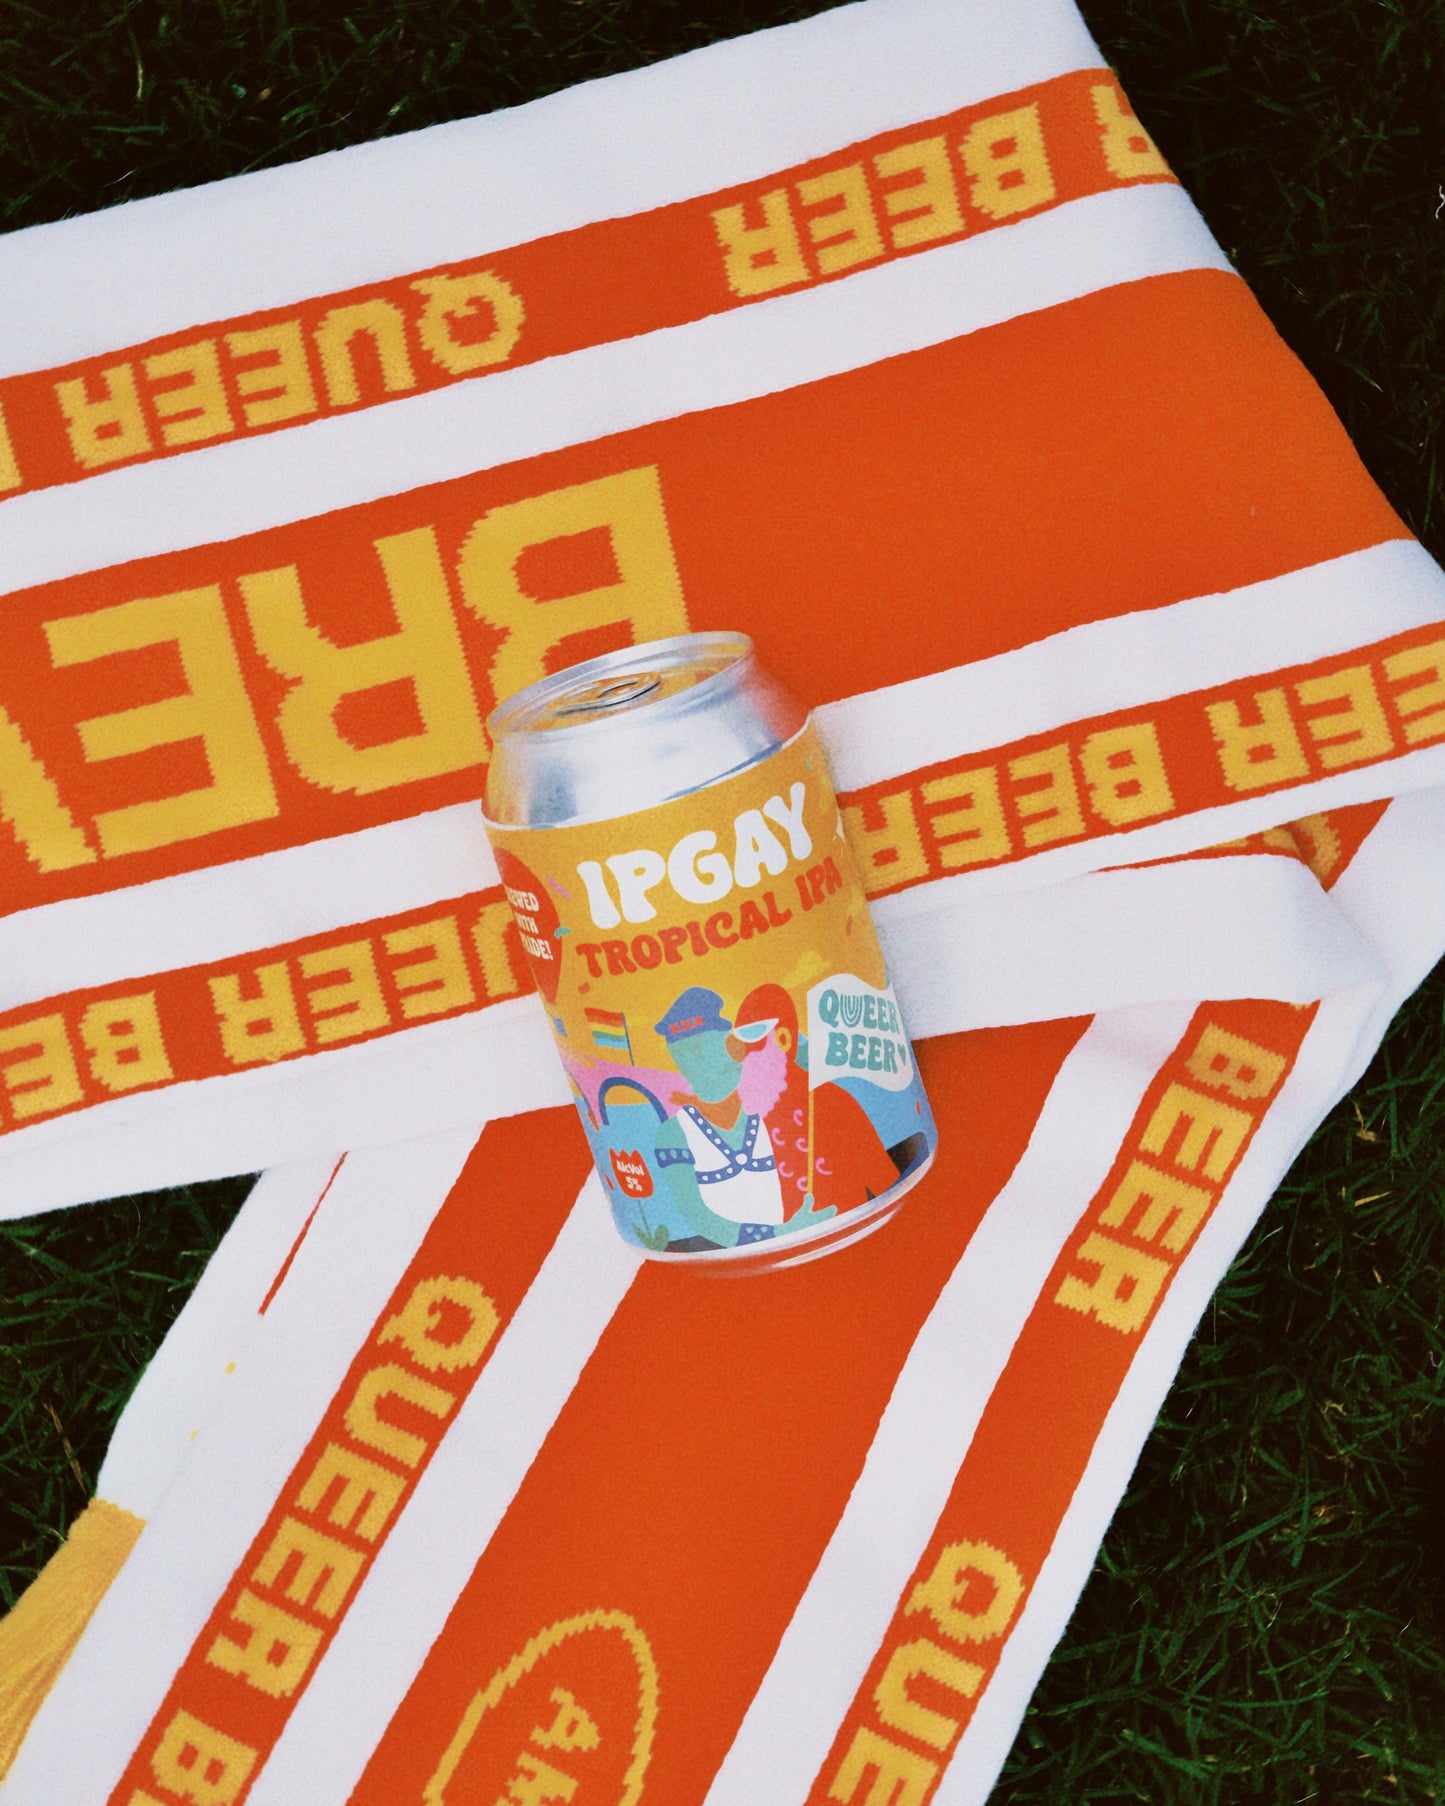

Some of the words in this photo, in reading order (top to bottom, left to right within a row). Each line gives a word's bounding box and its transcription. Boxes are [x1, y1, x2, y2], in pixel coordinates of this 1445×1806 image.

[712, 105, 1056, 298] BEER
[54, 272, 525, 469] QUEER
[576, 781, 813, 929] IPGAY
[843, 721, 1175, 891] BEER
[575, 890, 793, 978] TROPICAL
[794, 855, 843, 912] IPA
[0, 989, 174, 1121] BE
[818, 988, 900, 1035] QUEER
[825, 1031, 898, 1074] BEER
[1053, 1022, 1286, 1336] BEER
[206, 1274, 501, 1699] QUEER
